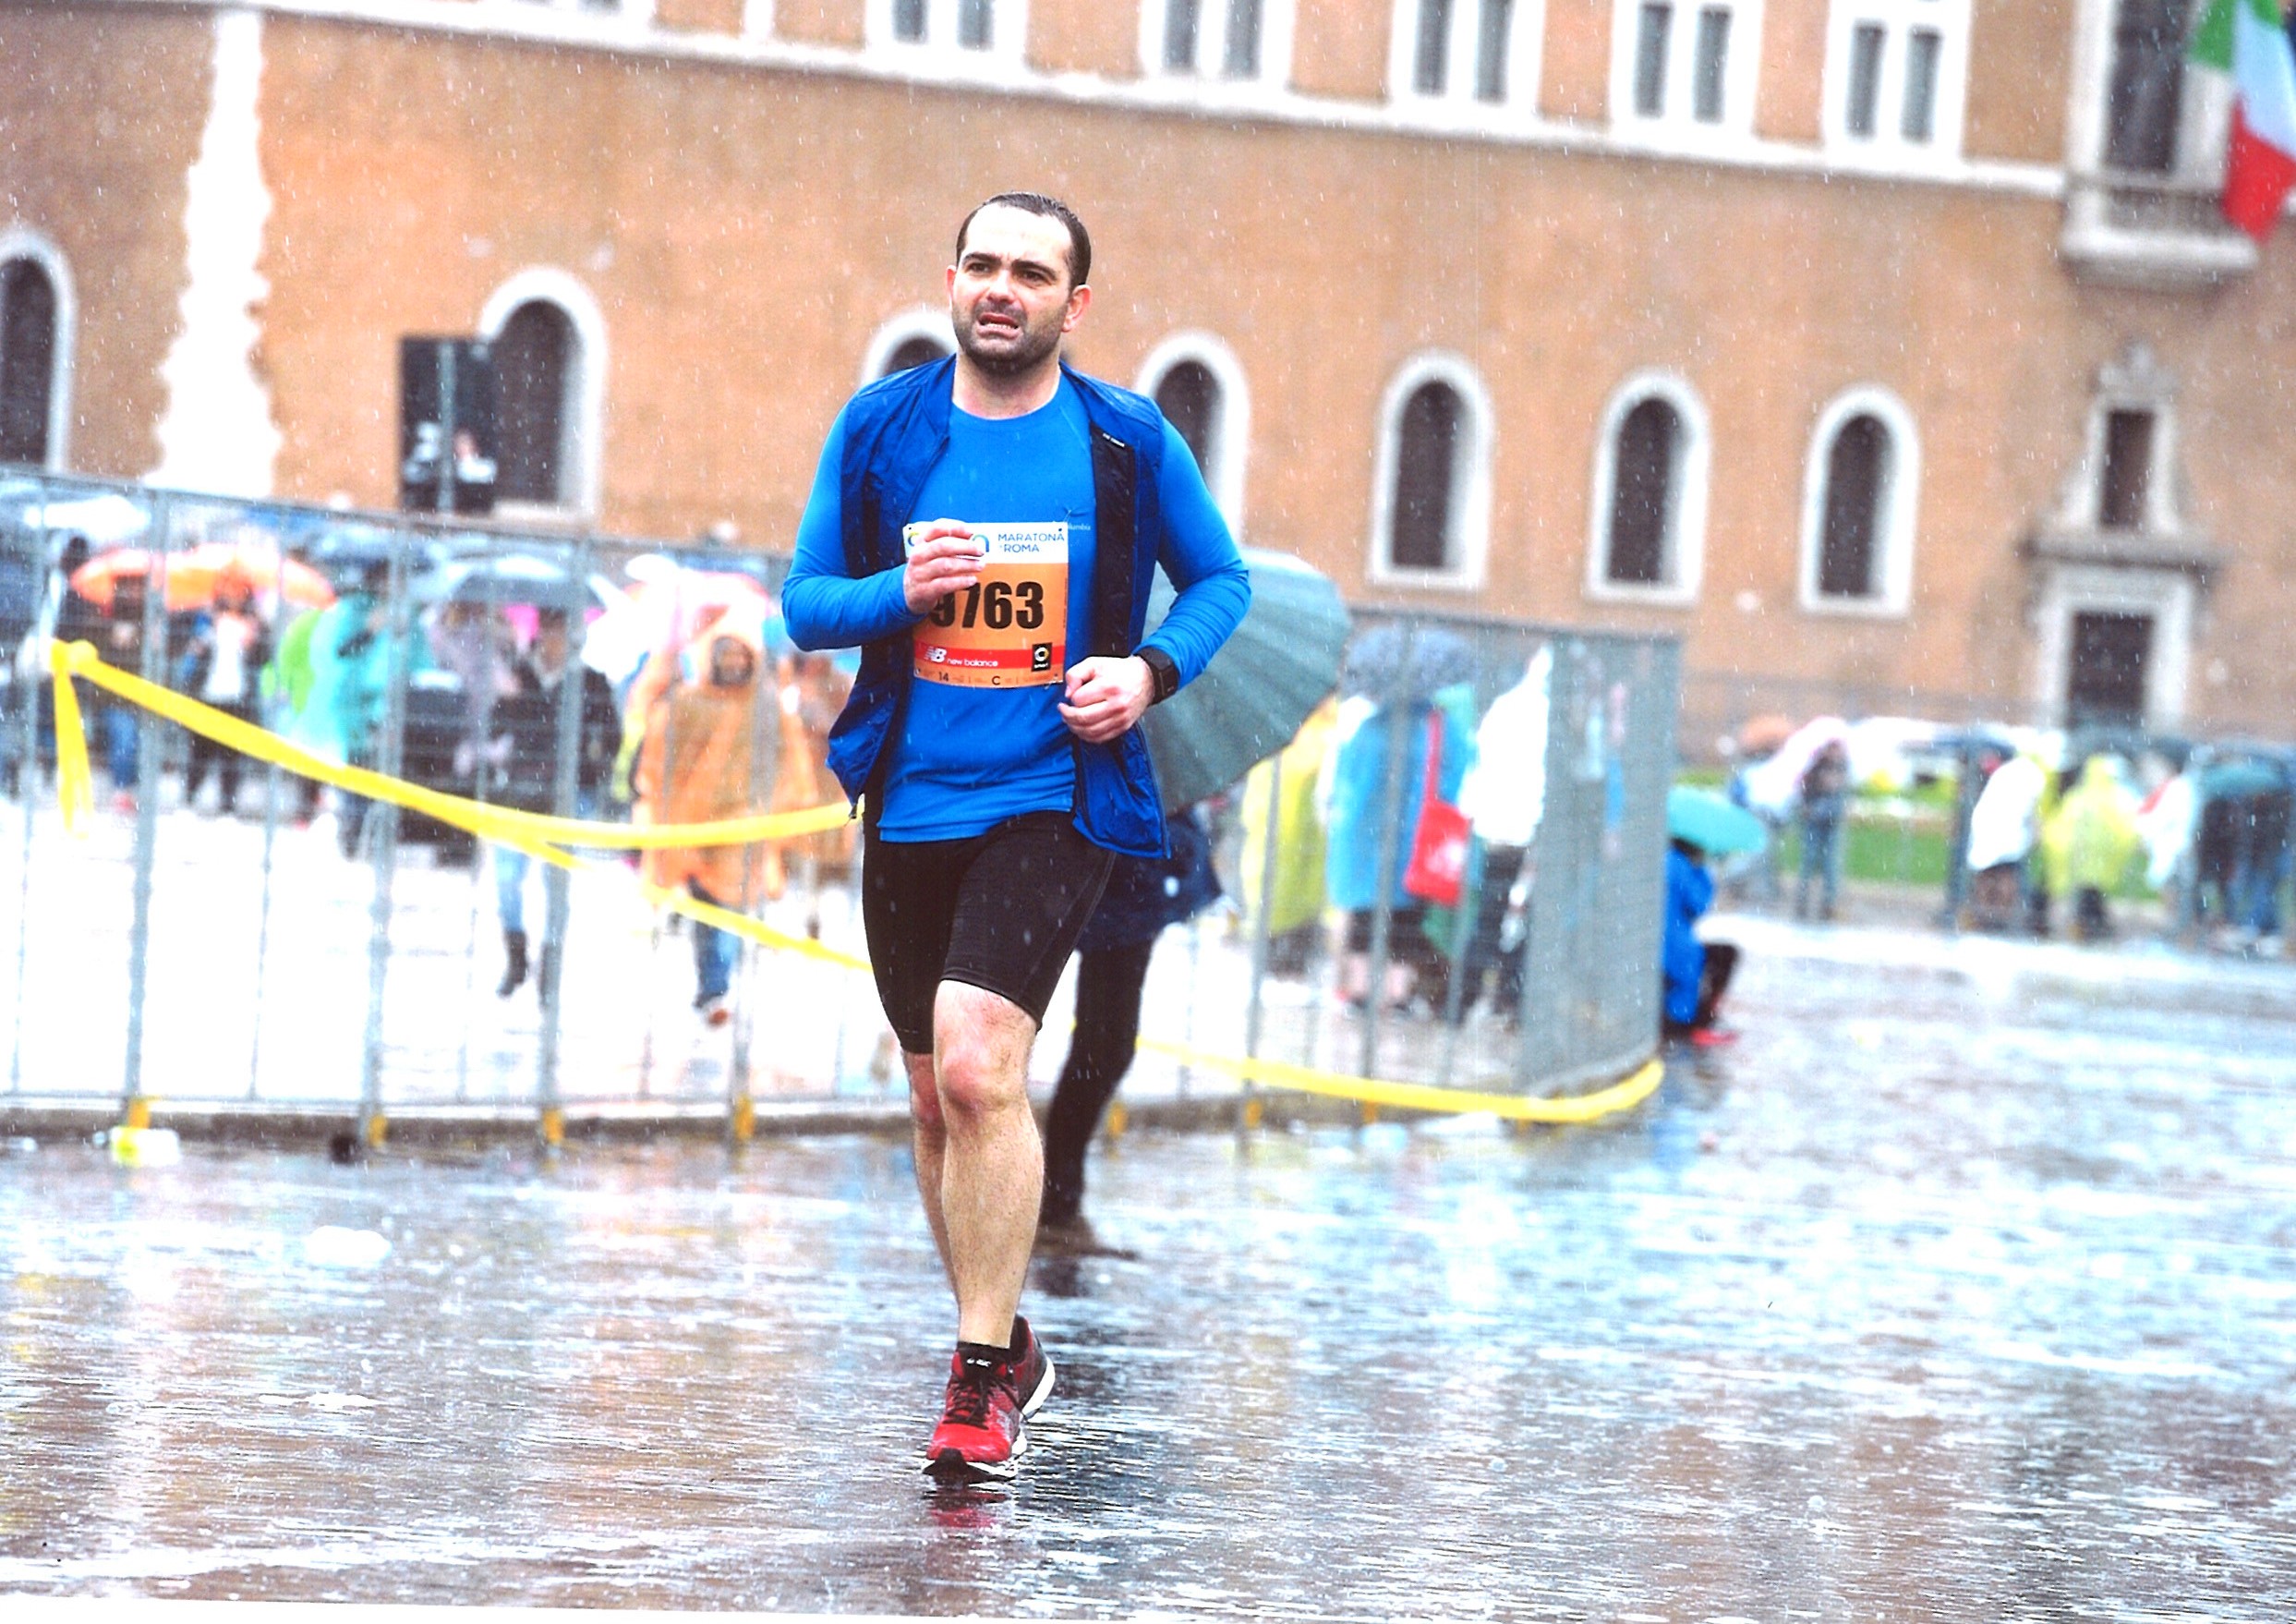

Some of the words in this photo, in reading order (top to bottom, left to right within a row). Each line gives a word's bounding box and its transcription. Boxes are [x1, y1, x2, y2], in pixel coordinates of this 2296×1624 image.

[997, 533, 1065, 542] MARATONA
[1004, 543, 1040, 553] ROMA
[963, 658, 998, 667] balance
[938, 671, 949, 682] 14
[991, 675, 1001, 685] C
